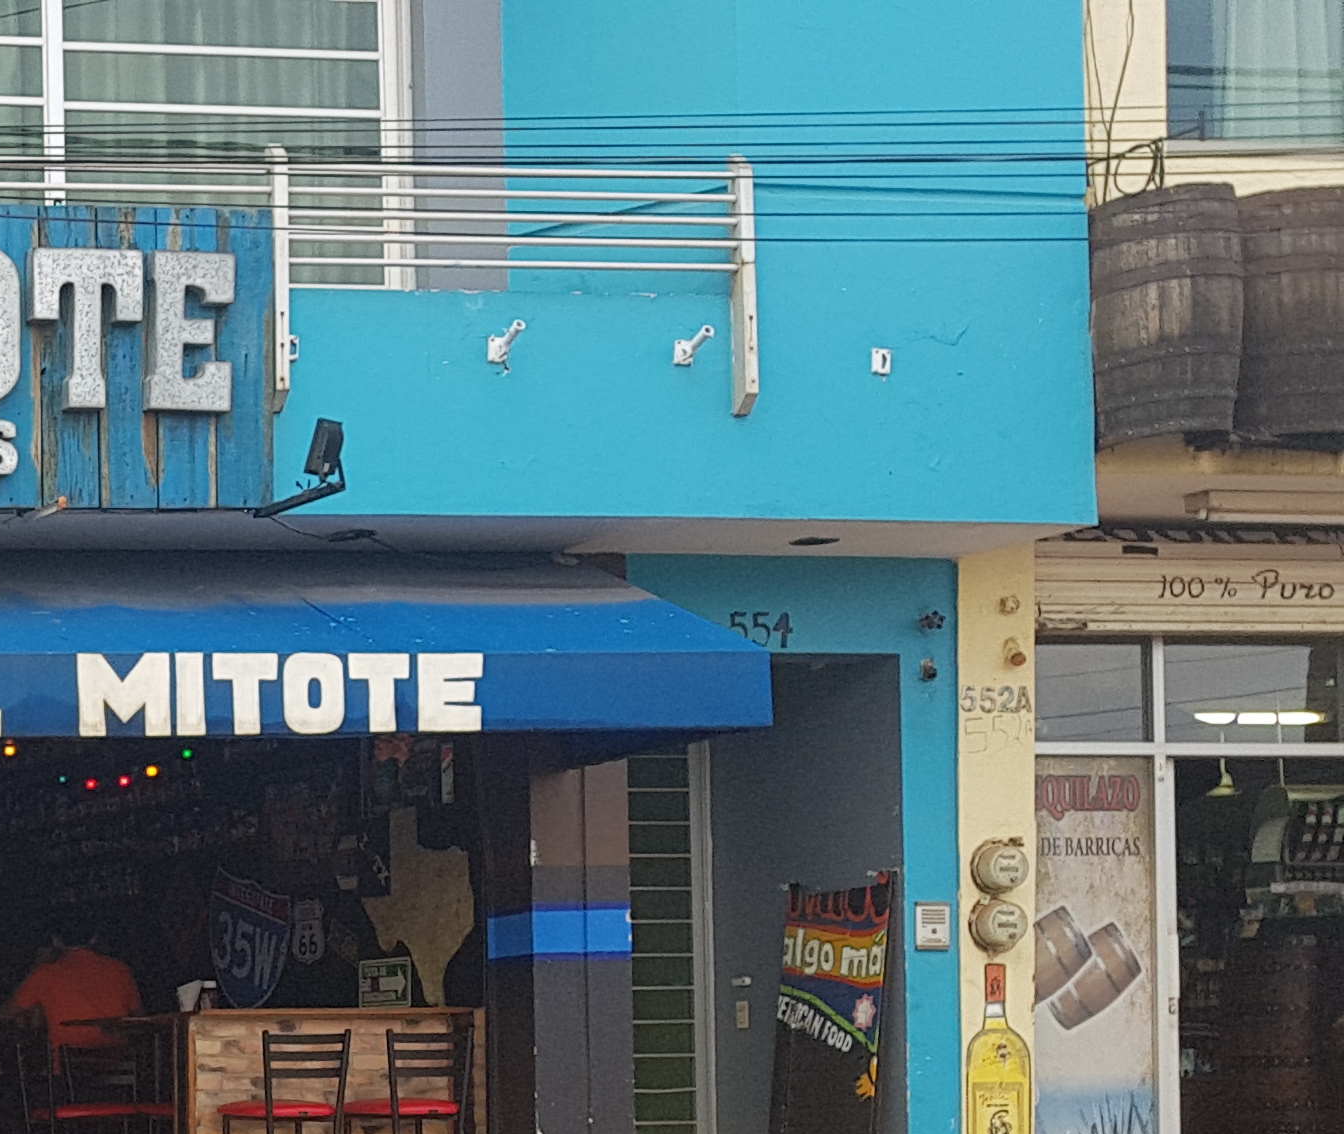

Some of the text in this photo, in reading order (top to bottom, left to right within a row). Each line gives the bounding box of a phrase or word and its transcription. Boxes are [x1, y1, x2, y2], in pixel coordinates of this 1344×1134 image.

[1158, 575, 1205, 599] 100
[730, 610, 793, 648] 554
[75, 652, 484, 737] MITOTE
[960, 685, 1032, 714] 552A
[1040, 837, 1140, 856] DE BARRICAS
[213, 910, 277, 991] 35W
[299, 933, 318, 956] 66
[783, 928, 834, 975] algo
[821, 1020, 852, 1053] FOOD
